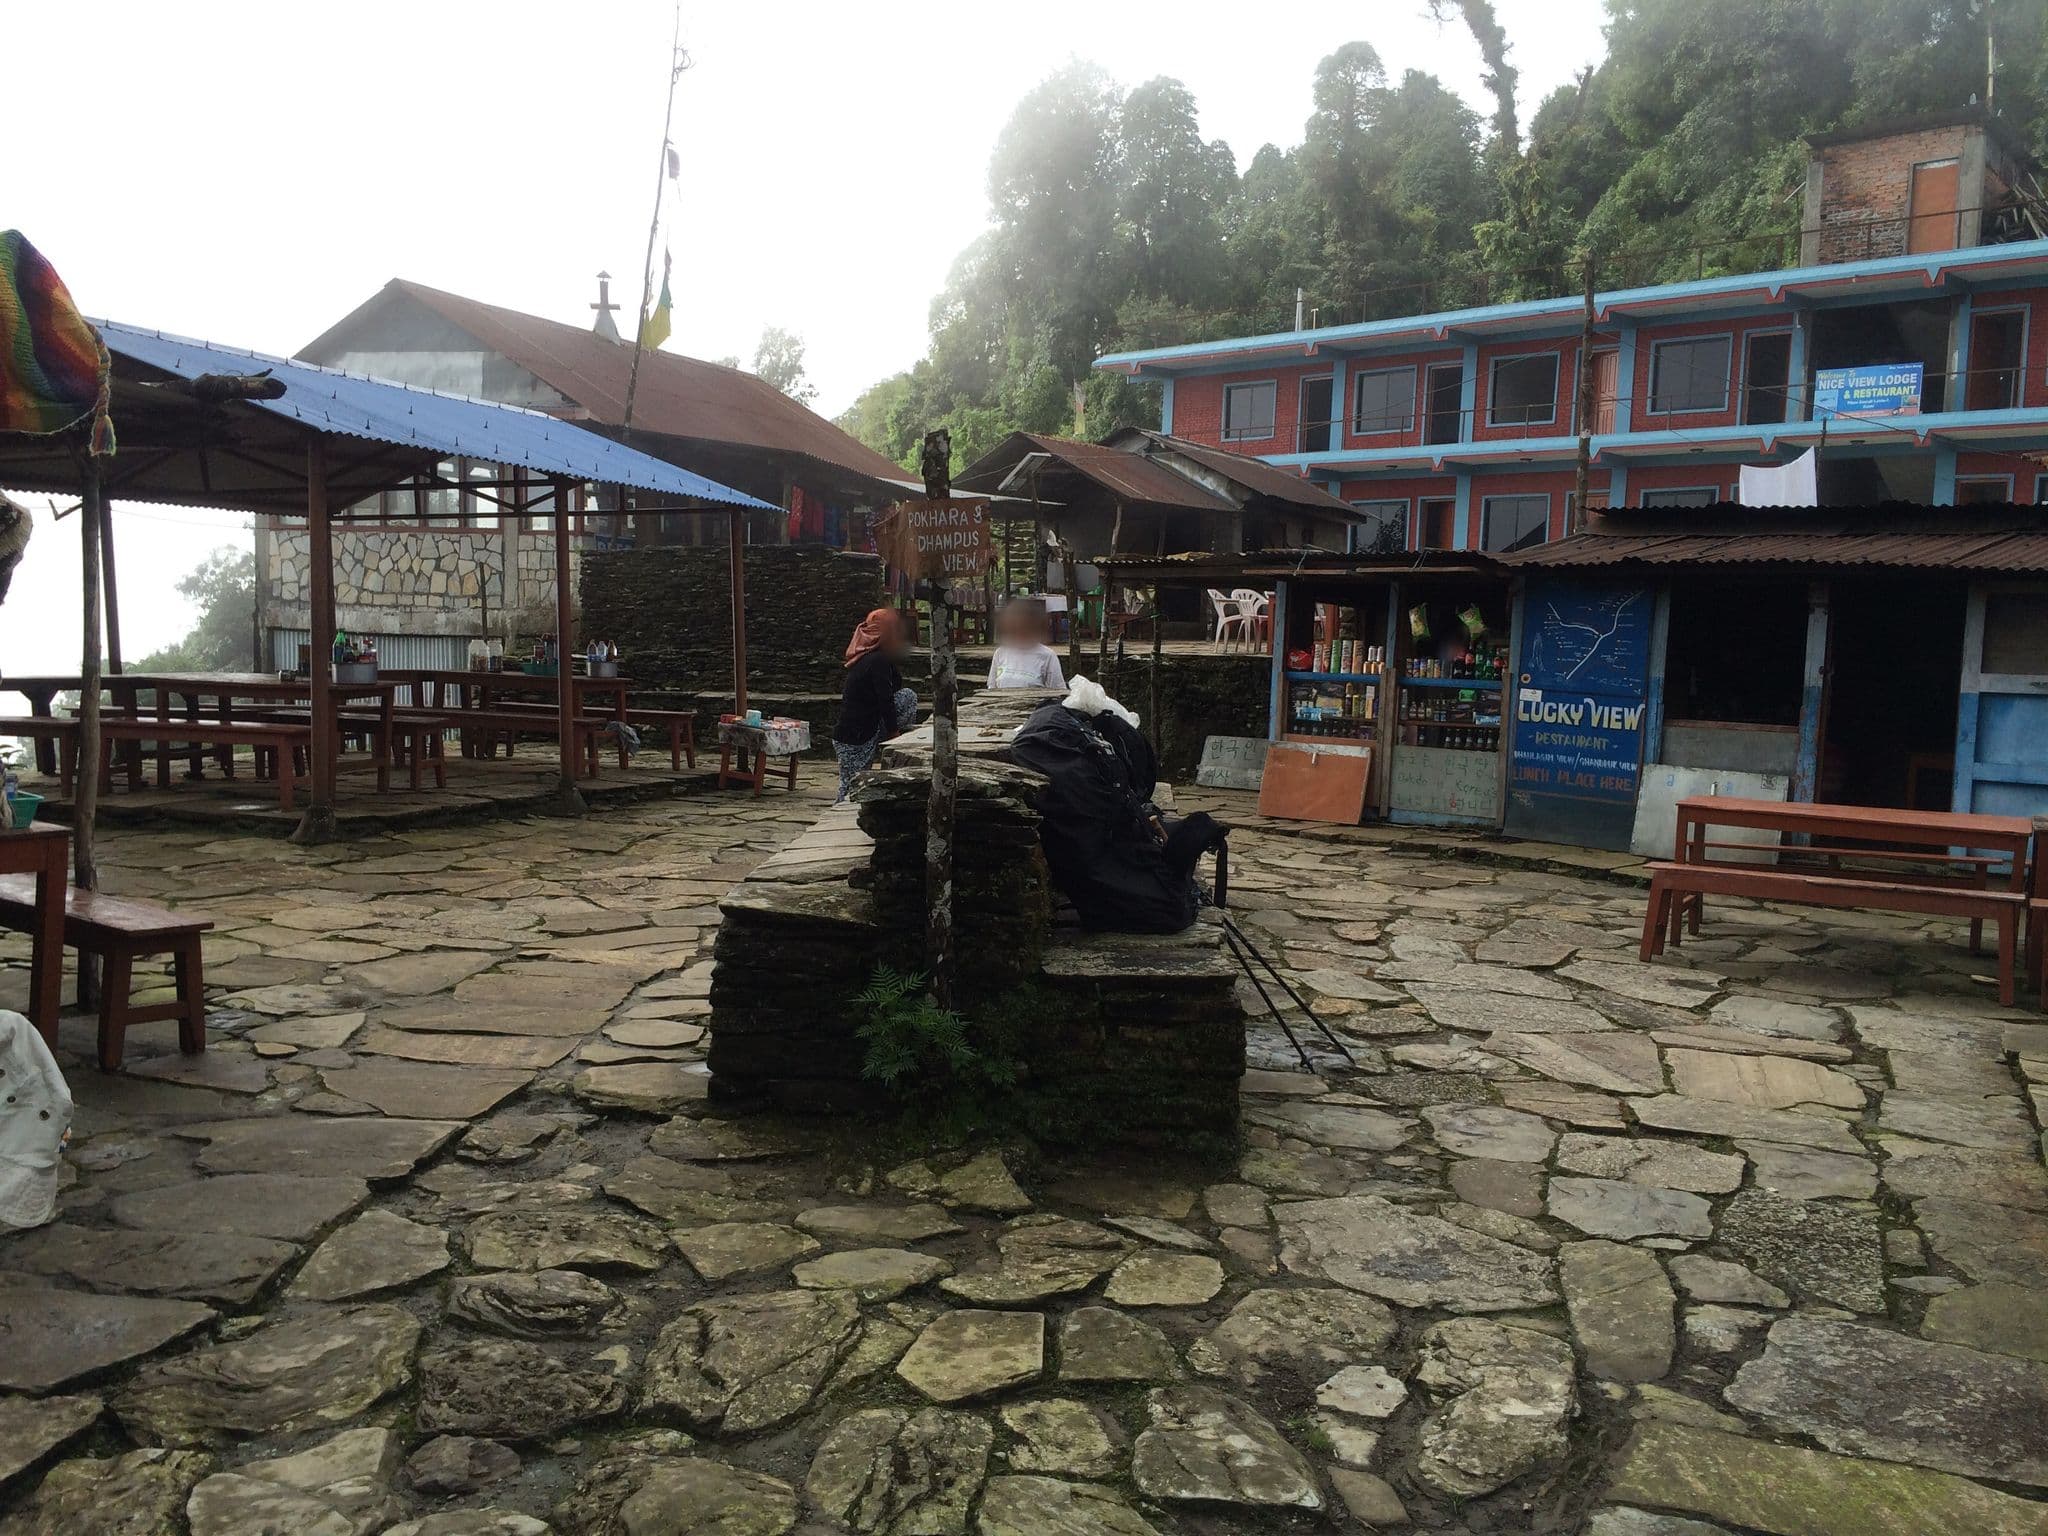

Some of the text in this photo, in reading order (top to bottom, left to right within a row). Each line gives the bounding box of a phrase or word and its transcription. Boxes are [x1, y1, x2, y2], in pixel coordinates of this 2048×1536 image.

[1819, 373, 1917, 389] NICE VIEW LODGE
[1843, 385, 1916, 399] & RESTAURANT
[908, 508, 969, 529] POKHARA
[917, 531, 979, 552] DHAMPUS
[942, 552, 977, 572] VIEW
[1518, 698, 1645, 730] LUCKY VIEW
[1211, 739, 1257, 760] 한국인
[1535, 731, 1608, 750] RESTAURANT
[1513, 766, 1632, 791] LUNCH PLACE HERE
